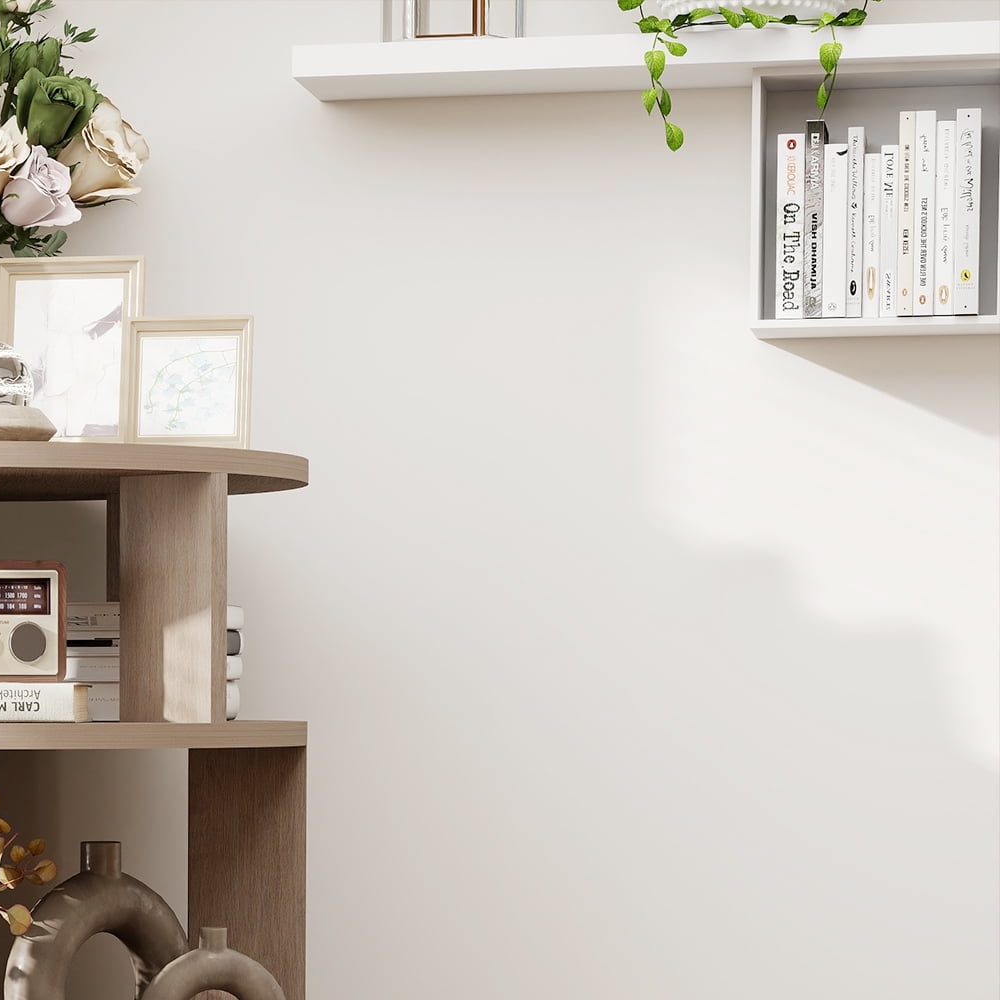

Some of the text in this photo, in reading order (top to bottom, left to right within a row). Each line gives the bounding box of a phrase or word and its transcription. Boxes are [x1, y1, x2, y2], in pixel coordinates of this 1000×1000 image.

[782, 203, 801, 311] On The Road
[11, 701, 40, 712] CARL
